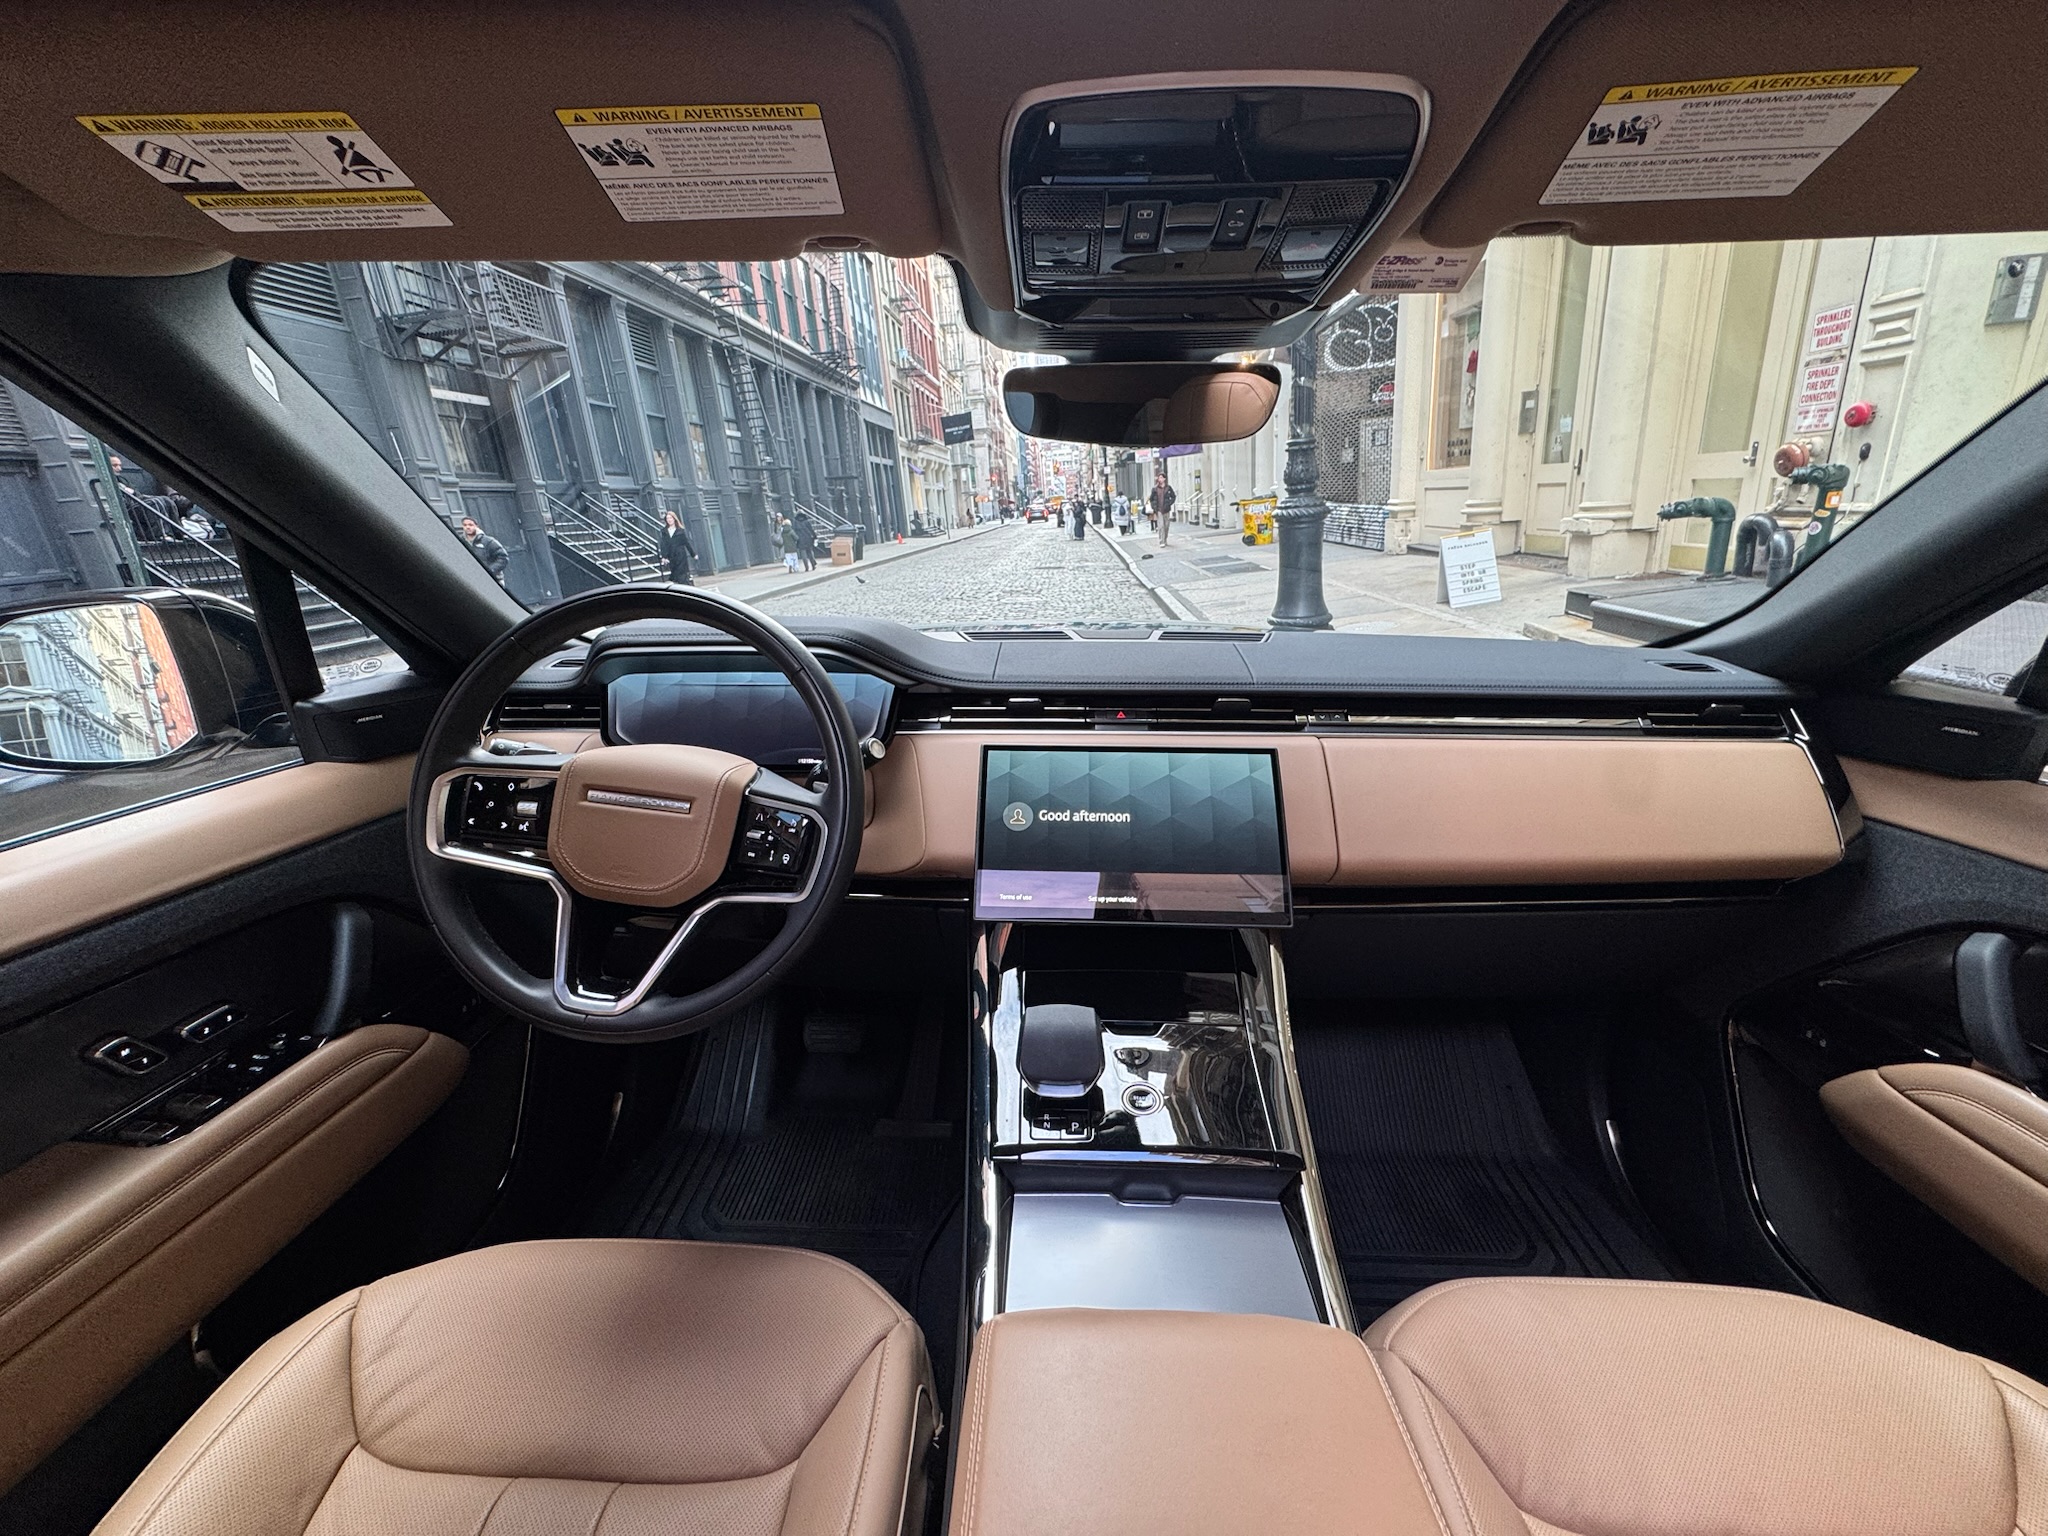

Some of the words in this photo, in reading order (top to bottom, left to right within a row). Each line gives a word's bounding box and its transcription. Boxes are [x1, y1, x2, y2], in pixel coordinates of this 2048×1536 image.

[1644, 81, 1733, 97] WARNING
[1742, 70, 1899, 91] AVERTISSEMENT
[1681, 100, 1712, 108] EVEN
[1711, 98, 1742, 106] WITH
[1740, 95, 1804, 104] ADVANCED
[1802, 91, 1858, 100] AIRBAGS
[593, 110, 670, 121] WARNING
[681, 106, 805, 119] AVERTISSEMENT
[107, 118, 199, 131] WARNING:
[196, 120, 252, 129] HIGHER
[247, 119, 320, 128] ROLLOVER
[316, 118, 353, 127] RISK
[1816, 308, 1852, 326] SPRINKLERS
[1813, 320, 1851, 336] THROUGHOUT
[1816, 334, 1843, 348] BUILDING
[1807, 366, 1840, 380] SPRINKLER
[1806, 381, 1819, 392] FIRE
[1819, 379, 1835, 390] DEPT.
[1801, 391, 1836, 404] CONNECTION
[1462, 577, 1483, 585] SPRING
[1463, 584, 1486, 593] ESCAPE
[590, 793, 635, 803] RANGE
[640, 798, 689, 810] ROVER
[1039, 809, 1070, 822] Good
[1073, 809, 1130, 823] afternoon
[1071, 1122, 1079, 1132] P
